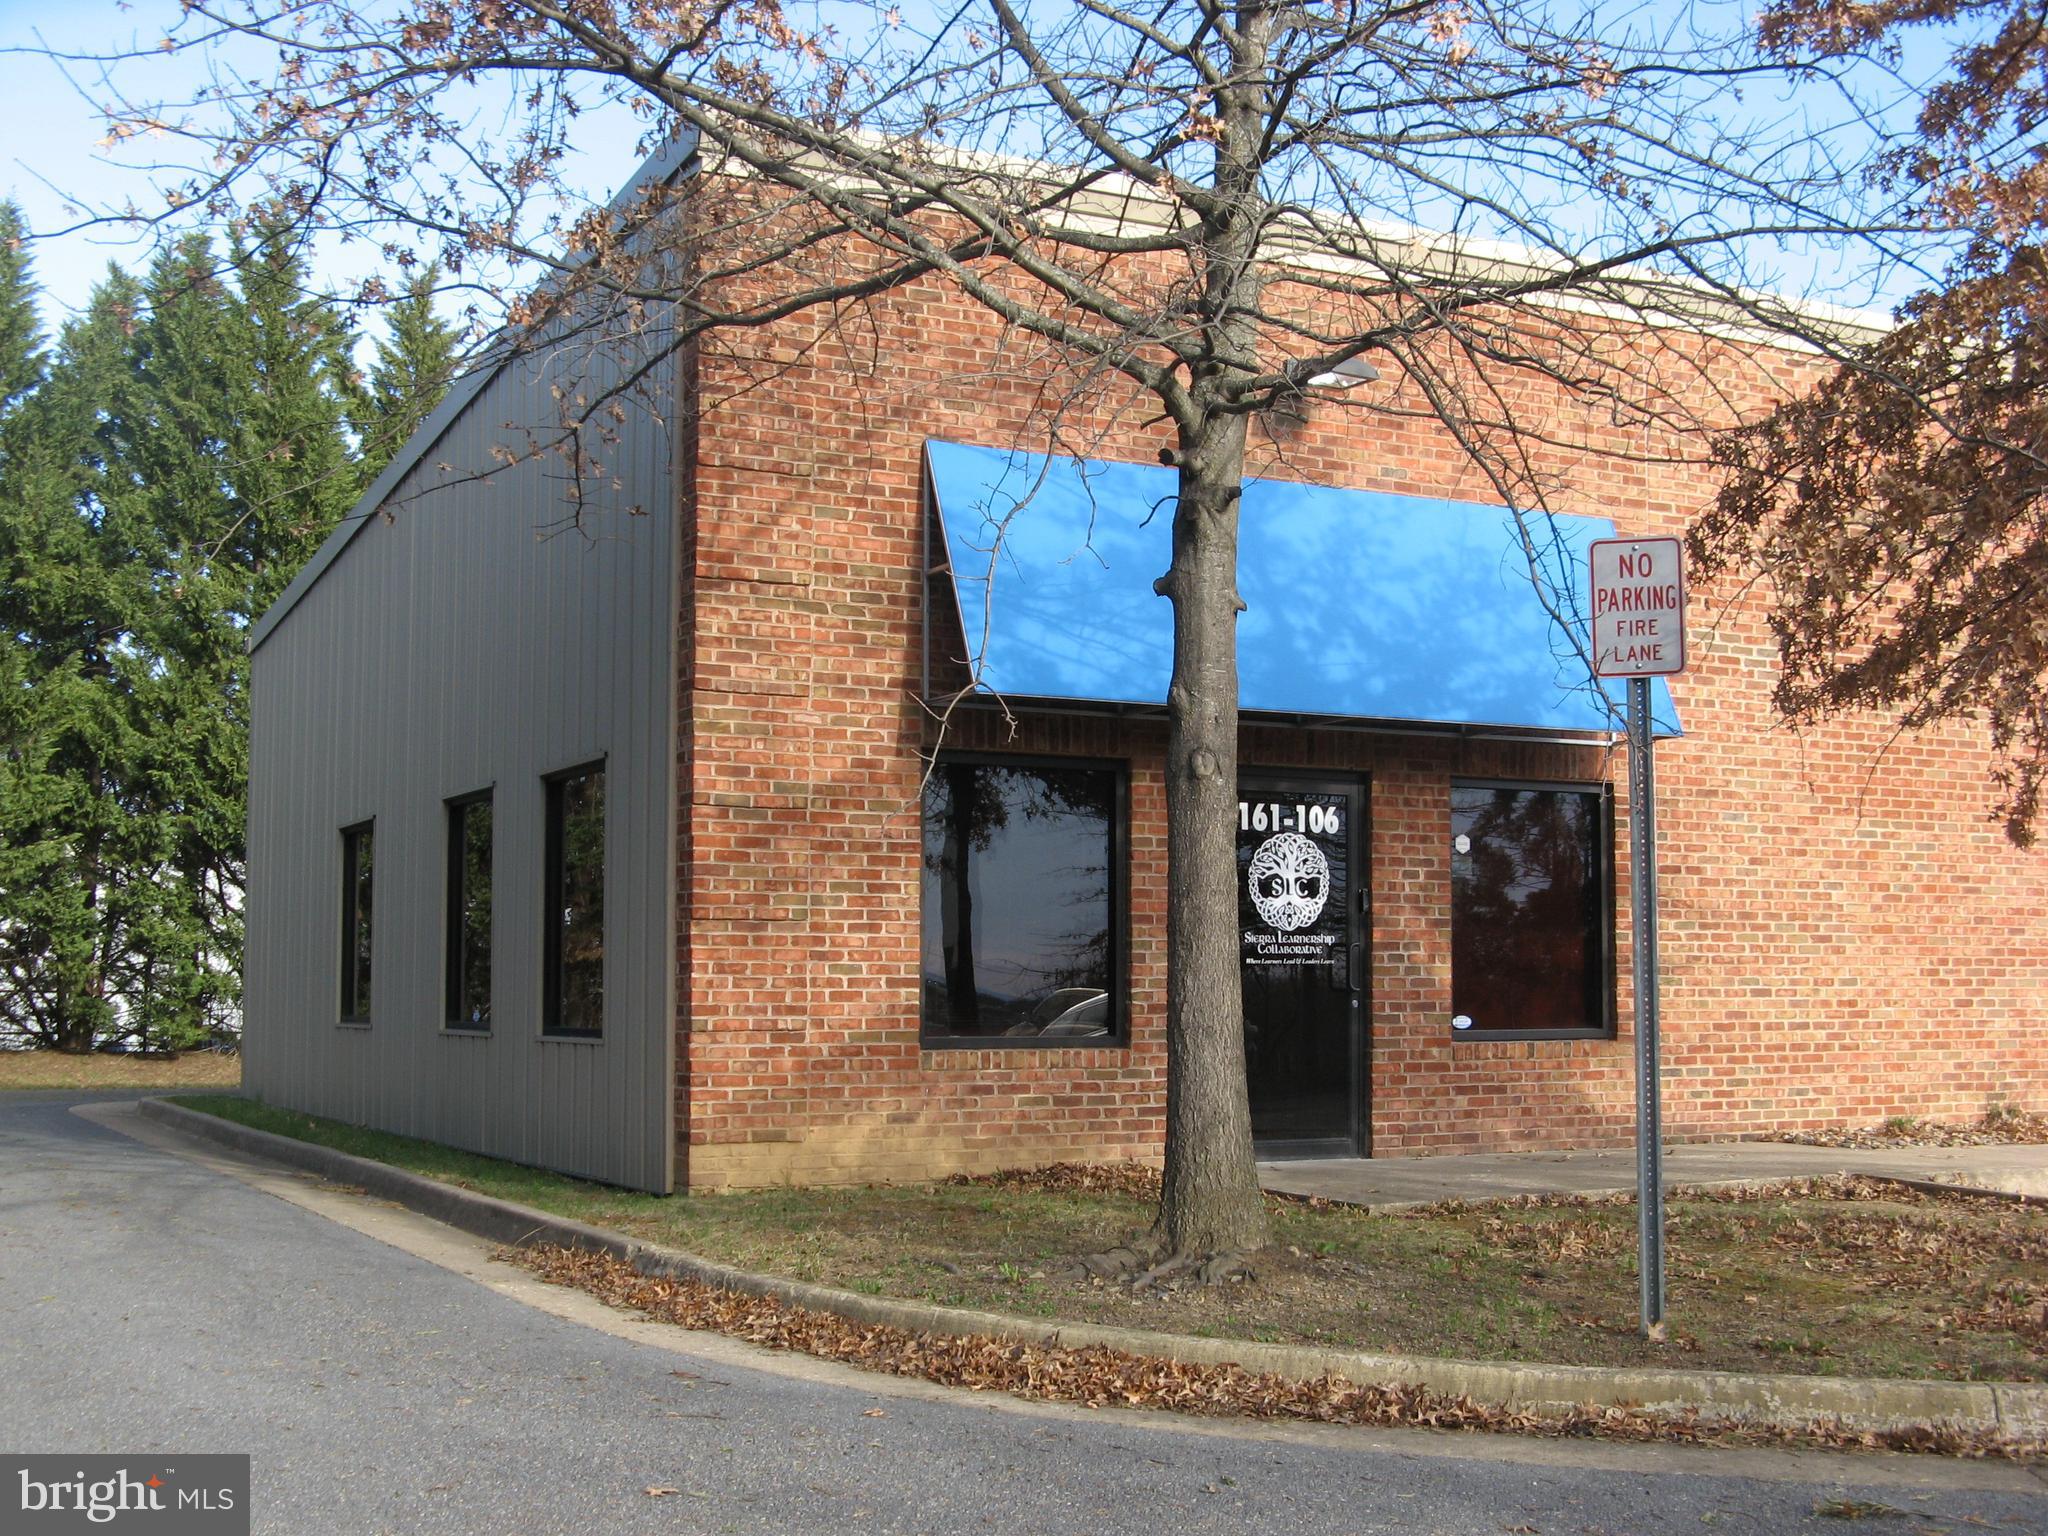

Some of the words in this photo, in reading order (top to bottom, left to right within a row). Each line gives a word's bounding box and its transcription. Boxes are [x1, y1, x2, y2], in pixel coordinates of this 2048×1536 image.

[1618, 553, 1653, 579] NO
[1597, 585, 1677, 613] PARKING
[1616, 618, 1659, 637] FIRE
[1614, 644, 1664, 663] LANE
[1239, 802, 1340, 834] 161-106
